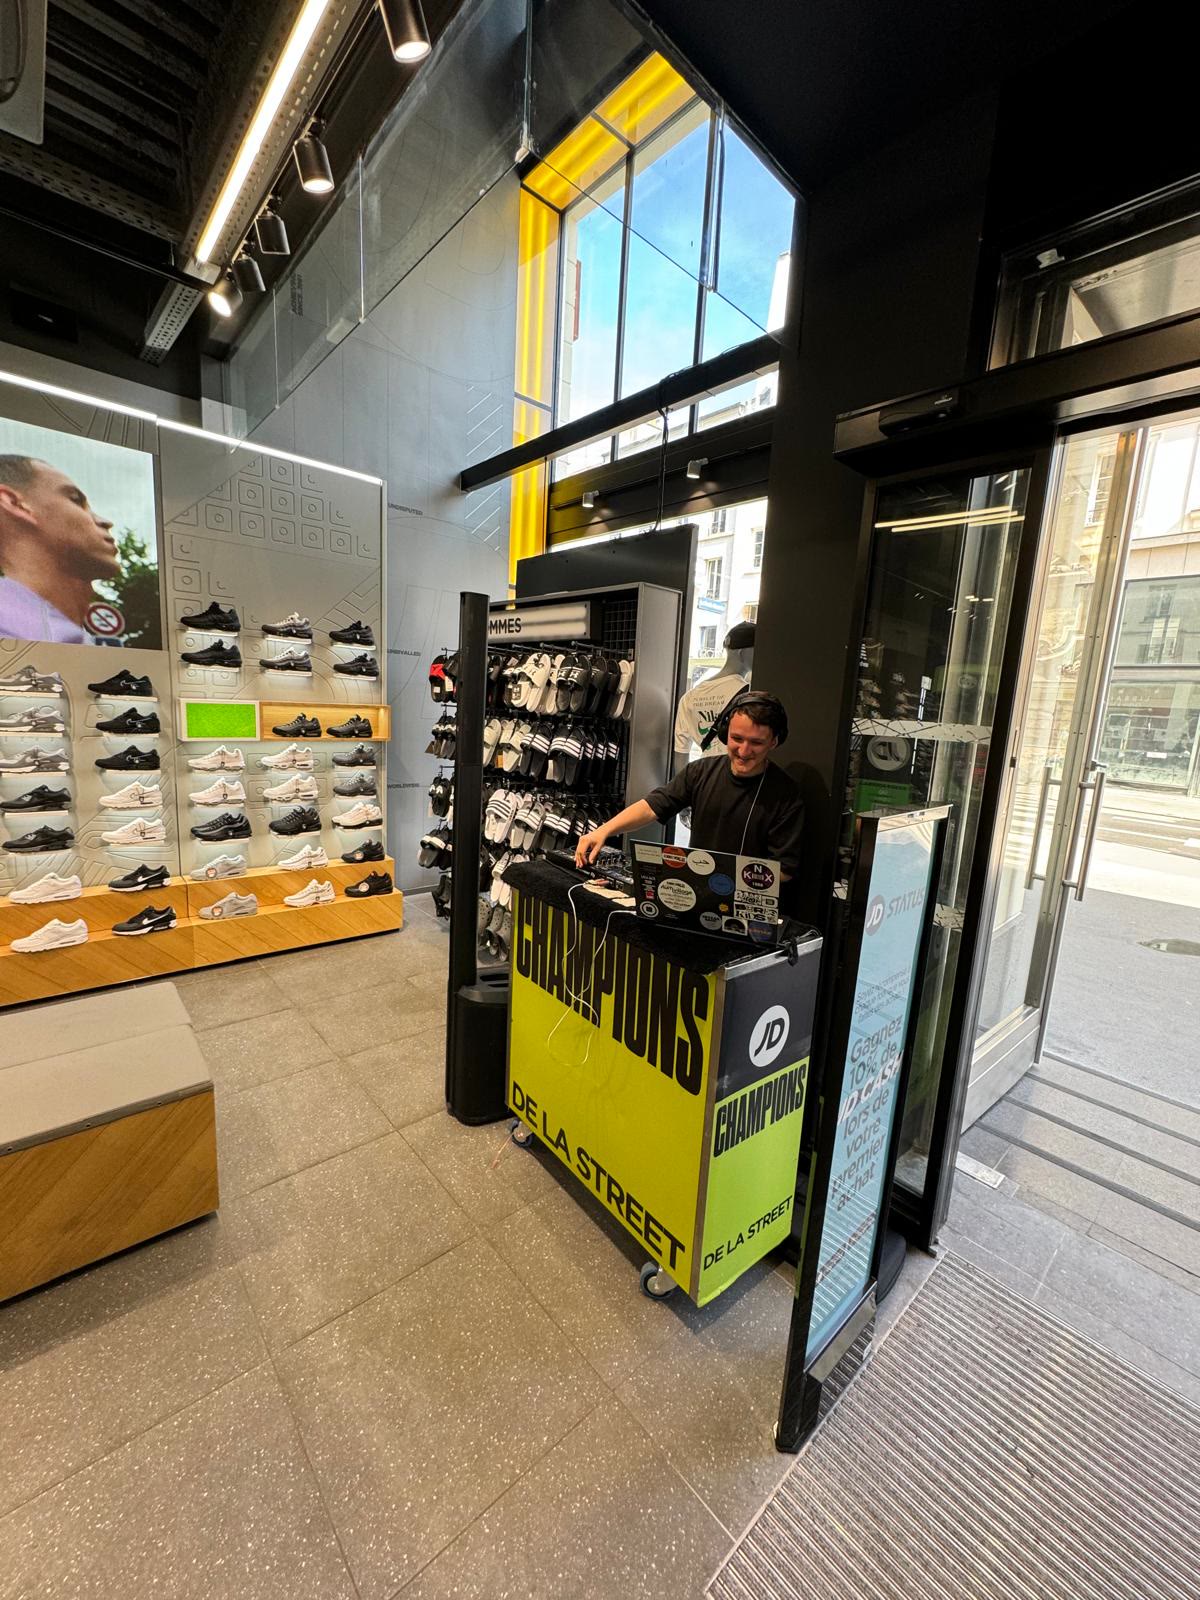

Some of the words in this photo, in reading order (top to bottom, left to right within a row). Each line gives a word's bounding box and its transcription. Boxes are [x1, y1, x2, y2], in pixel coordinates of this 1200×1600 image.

[489, 617, 522, 635] MMES
[698, 710, 721, 722] Nik
[867, 903, 884, 928] JD
[887, 888, 925, 918] STATUS
[515, 898, 709, 1096] CHAMPIONS
[754, 1017, 786, 1057] JD
[850, 1015, 904, 1063] Gagnez
[850, 1055, 878, 1091] 10%
[880, 1041, 898, 1065] de
[712, 1062, 808, 1158] CHAMPIONS
[843, 1105, 870, 1141] lors
[872, 1088, 890, 1112] de
[845, 1117, 881, 1159] votre
[512, 1080, 538, 1126] DE
[541, 1111, 571, 1164] LA
[575, 1147, 686, 1272] STREET
[703, 1249, 724, 1272] DE
[726, 1233, 745, 1256] LA
[747, 1194, 793, 1239] STREET
